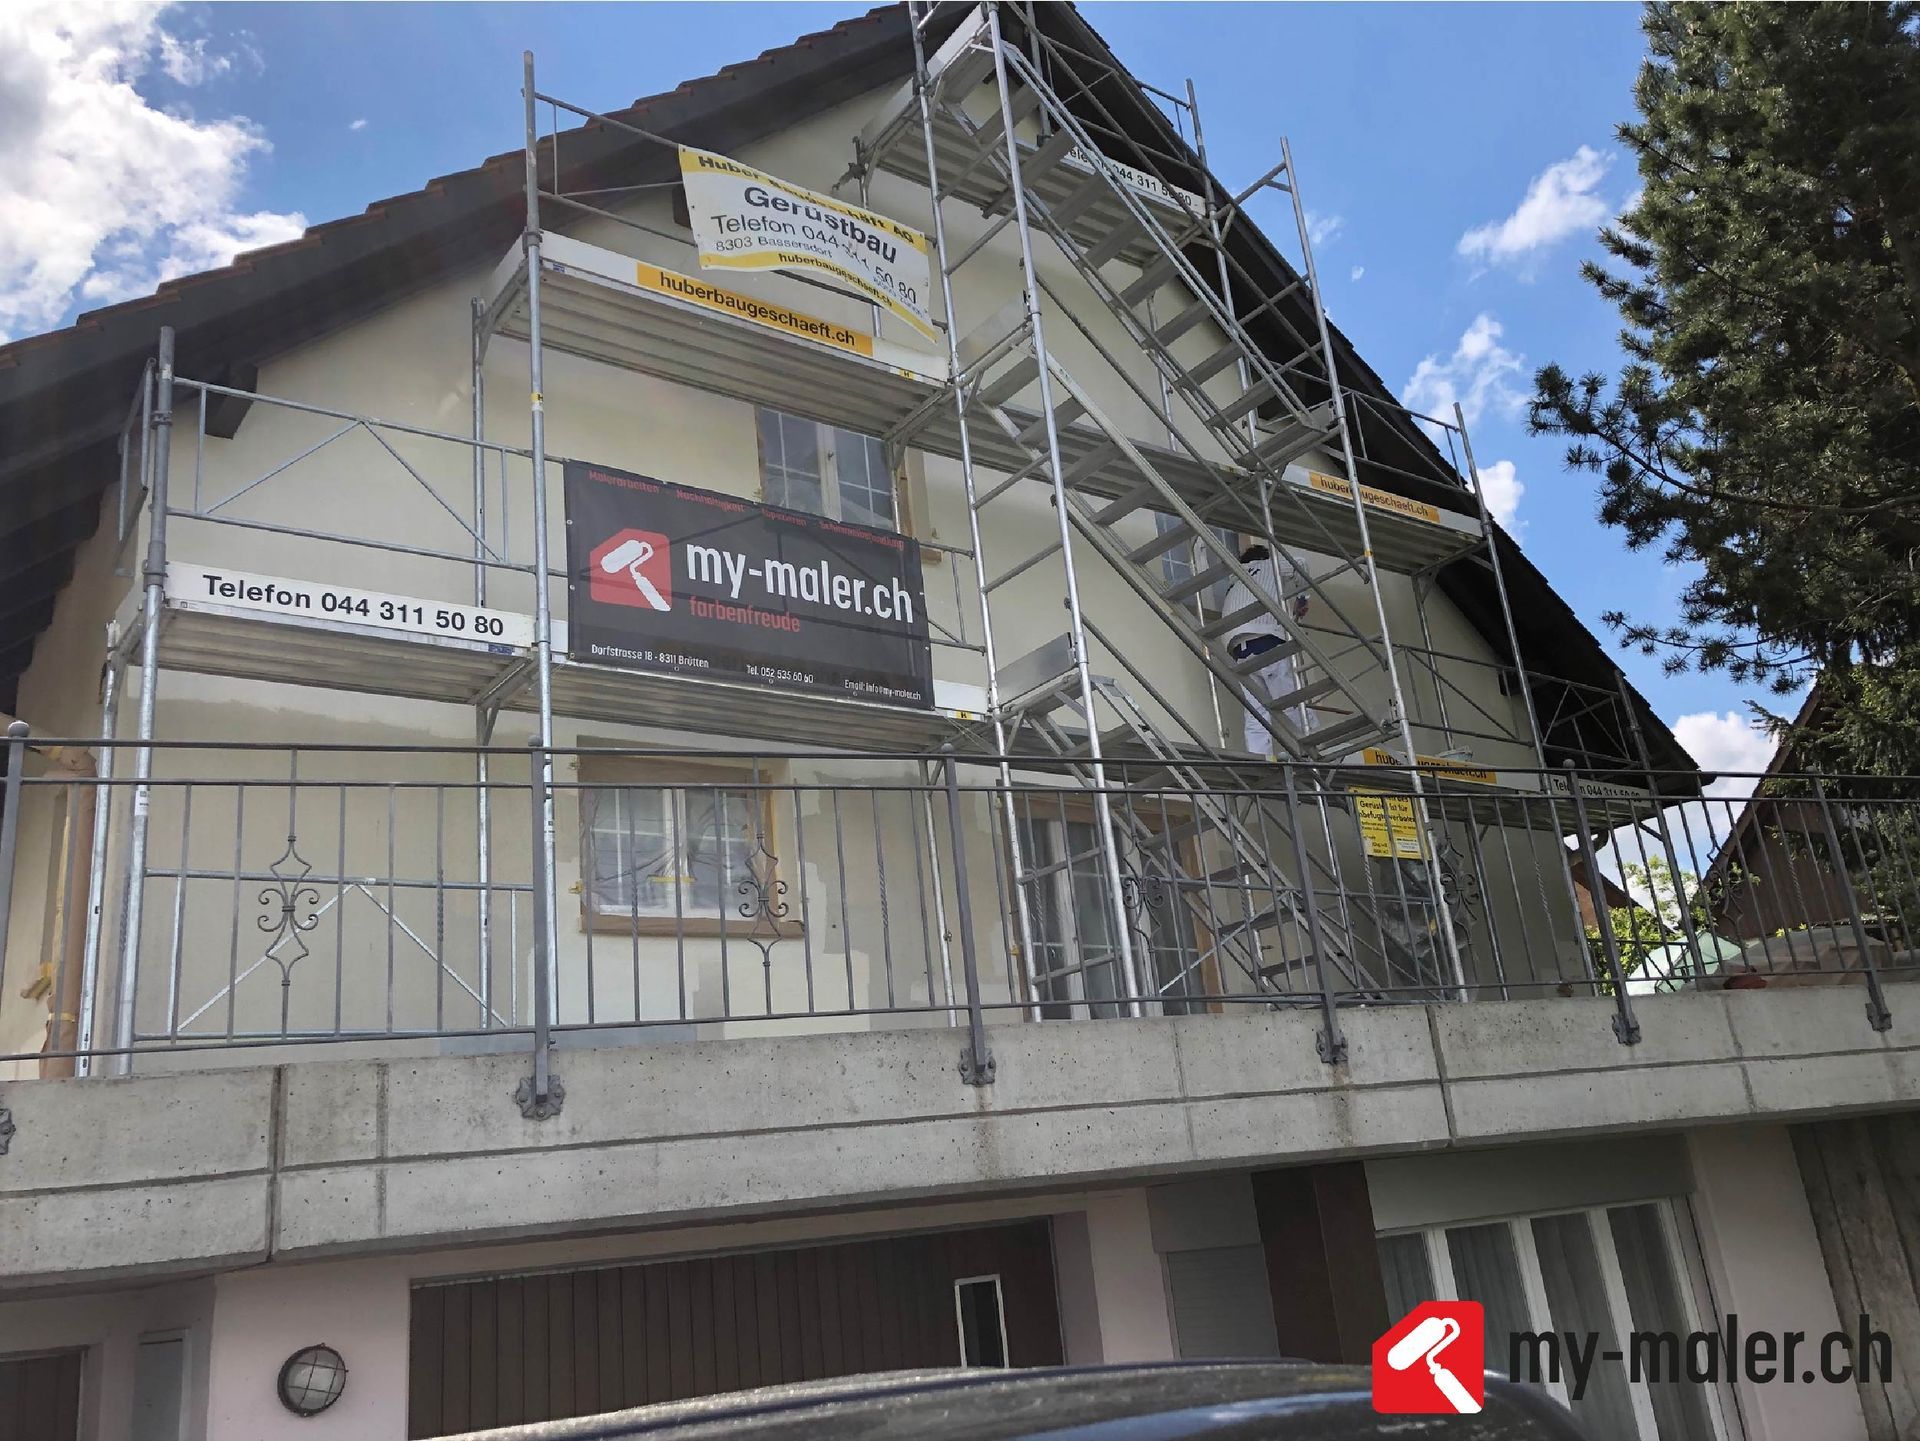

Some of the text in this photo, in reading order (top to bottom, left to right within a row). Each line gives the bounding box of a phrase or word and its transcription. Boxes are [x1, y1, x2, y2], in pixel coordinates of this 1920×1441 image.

[698, 155, 760, 180] Huber
[1137, 174, 1157, 192] 311
[716, 236, 753, 252] 8303
[744, 186, 897, 264] Gerüstbau
[710, 214, 796, 235] Telefon
[802, 225, 840, 248] 044
[875, 266, 894, 290] 50
[898, 281, 917, 304] 80
[660, 271, 855, 346] huberbaugeschaeft.ch
[1320, 476, 1429, 518] huberugeschaeft.ch
[686, 543, 914, 624] my-maler.ch
[202, 574, 504, 637] Telefon 044 311 50 80
[689, 595, 801, 633] farbenfreude
[591, 644, 642, 660] Dorfstrasse
[644, 650, 653, 661] 18
[659, 652, 677, 664] 8311
[678, 655, 709, 669] Brütten
[746, 664, 814, 684] Tel. 052 535 60 60
[1359, 810, 1386, 821] nbefugt
